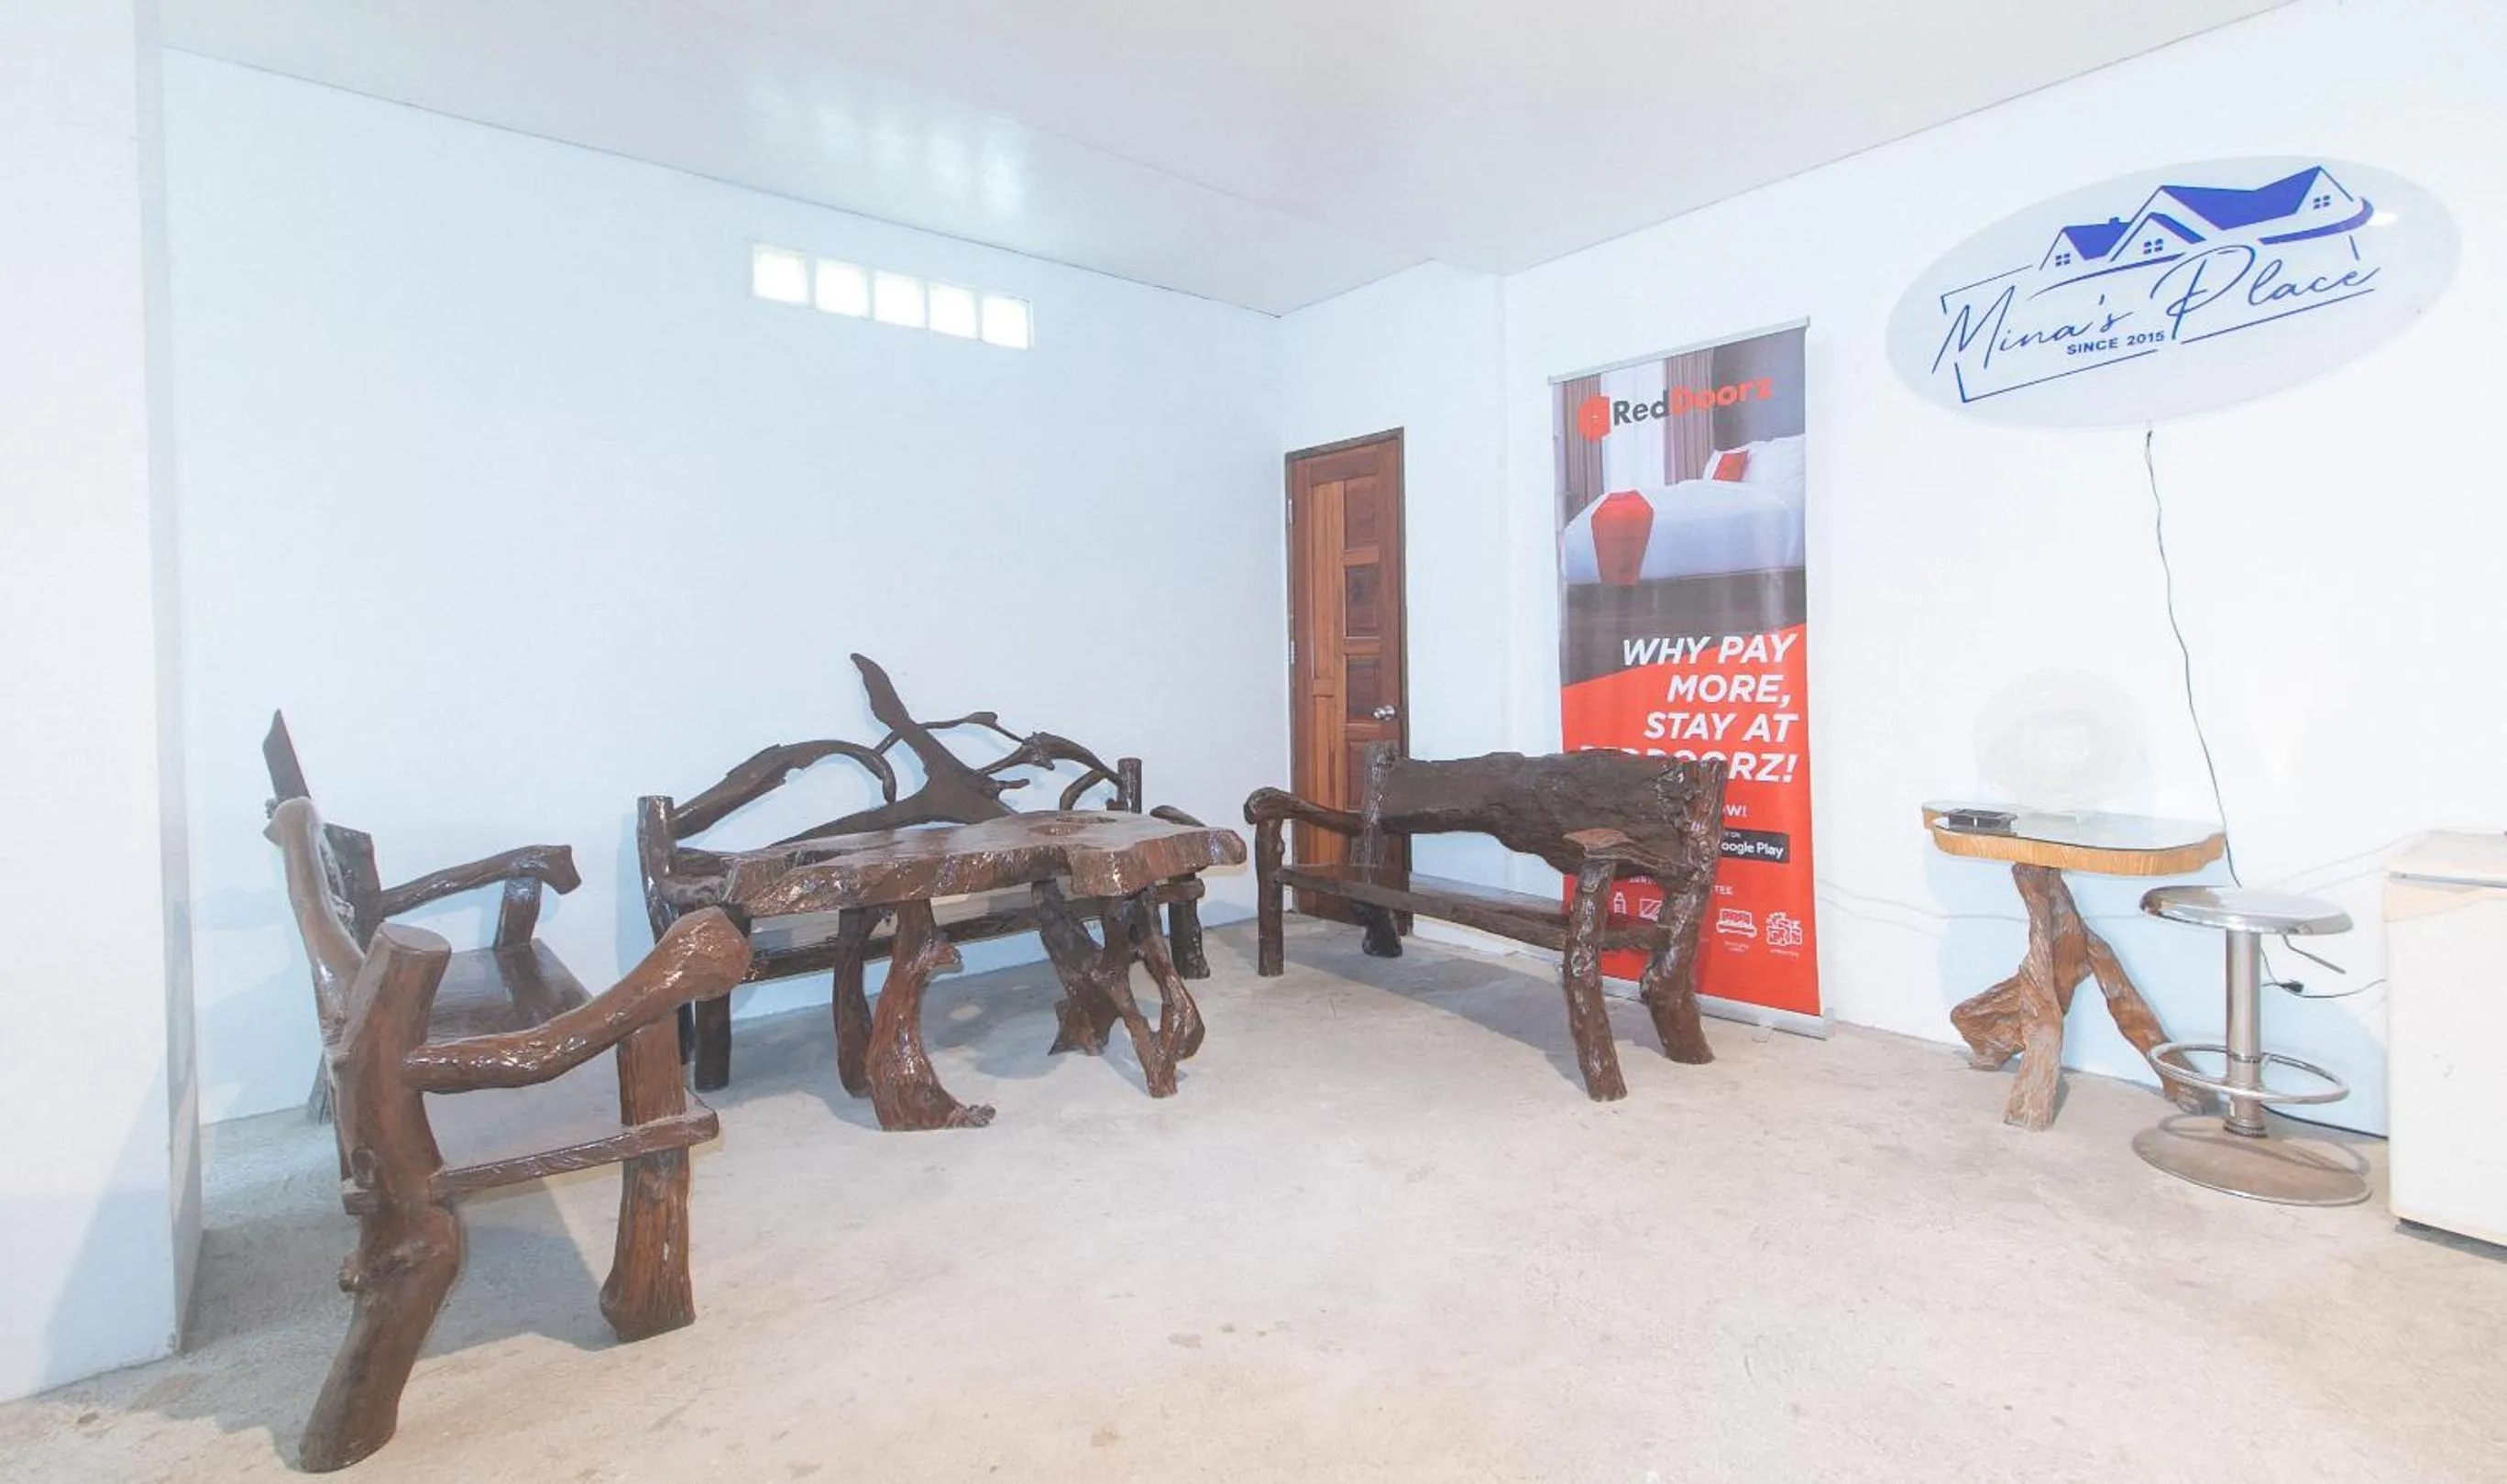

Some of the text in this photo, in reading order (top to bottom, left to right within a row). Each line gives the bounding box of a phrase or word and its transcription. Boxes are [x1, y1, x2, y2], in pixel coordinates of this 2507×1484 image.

[1931, 245, 2381, 375] Mina's Place
[2067, 330, 2165, 356] SINCE 2015
[1612, 377, 1774, 426] RedDoorz
[1623, 633, 1798, 666] WHY PAY
[1666, 674, 1792, 709] MORE,
[1643, 711, 1800, 743] STAY AT
[1721, 841, 1784, 859] oogle Play
